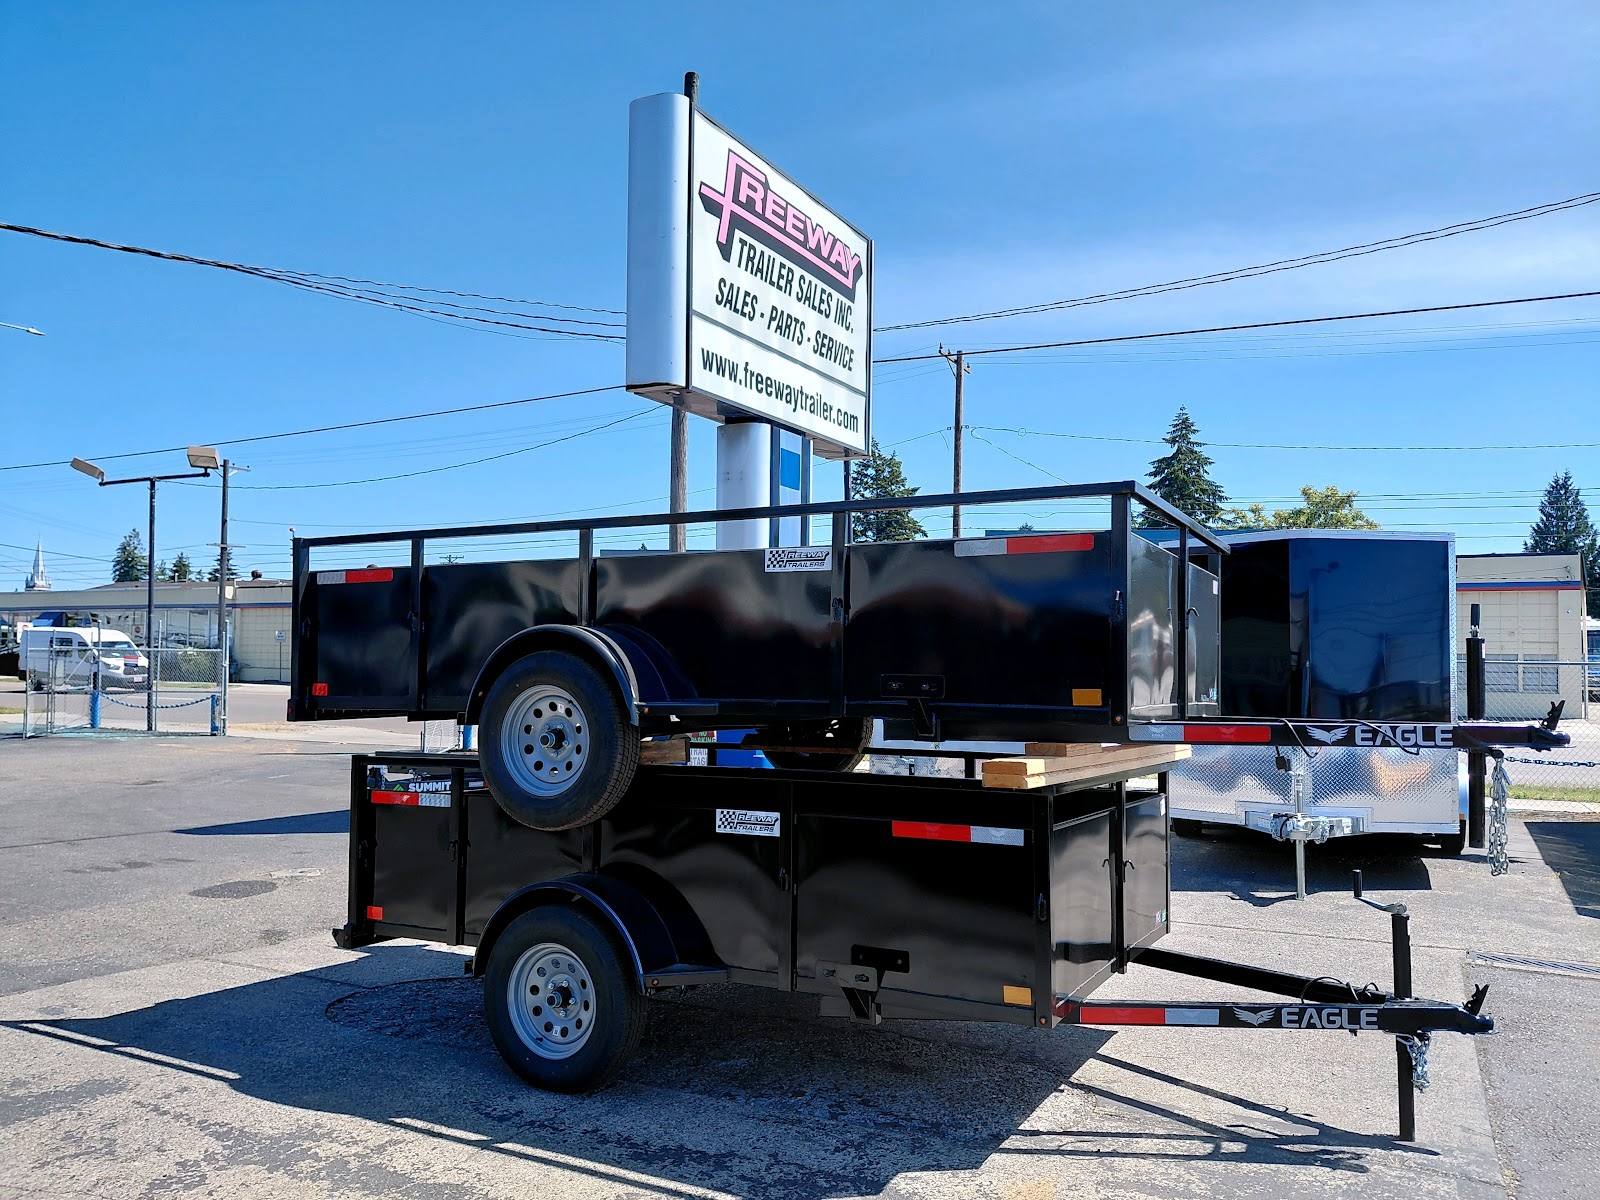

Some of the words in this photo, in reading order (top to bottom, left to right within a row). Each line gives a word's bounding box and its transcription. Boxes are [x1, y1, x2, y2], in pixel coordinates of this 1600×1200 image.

[699, 149, 862, 294] FREEWAY
[737, 237, 795, 297] TRAILER
[796, 274, 832, 319] SALES
[834, 298, 854, 333] INC.
[716, 277, 758, 322] SALES
[767, 305, 806, 346] PARTS
[813, 330, 855, 372] SERVICE
[701, 347, 859, 433] www.freewaytrailer.com
[1355, 725, 1454, 746] EAGLE
[408, 781, 452, 792] SUMMIT
[738, 825, 774, 833] TRAILERS
[1281, 1007, 1379, 1030] EAGLE
